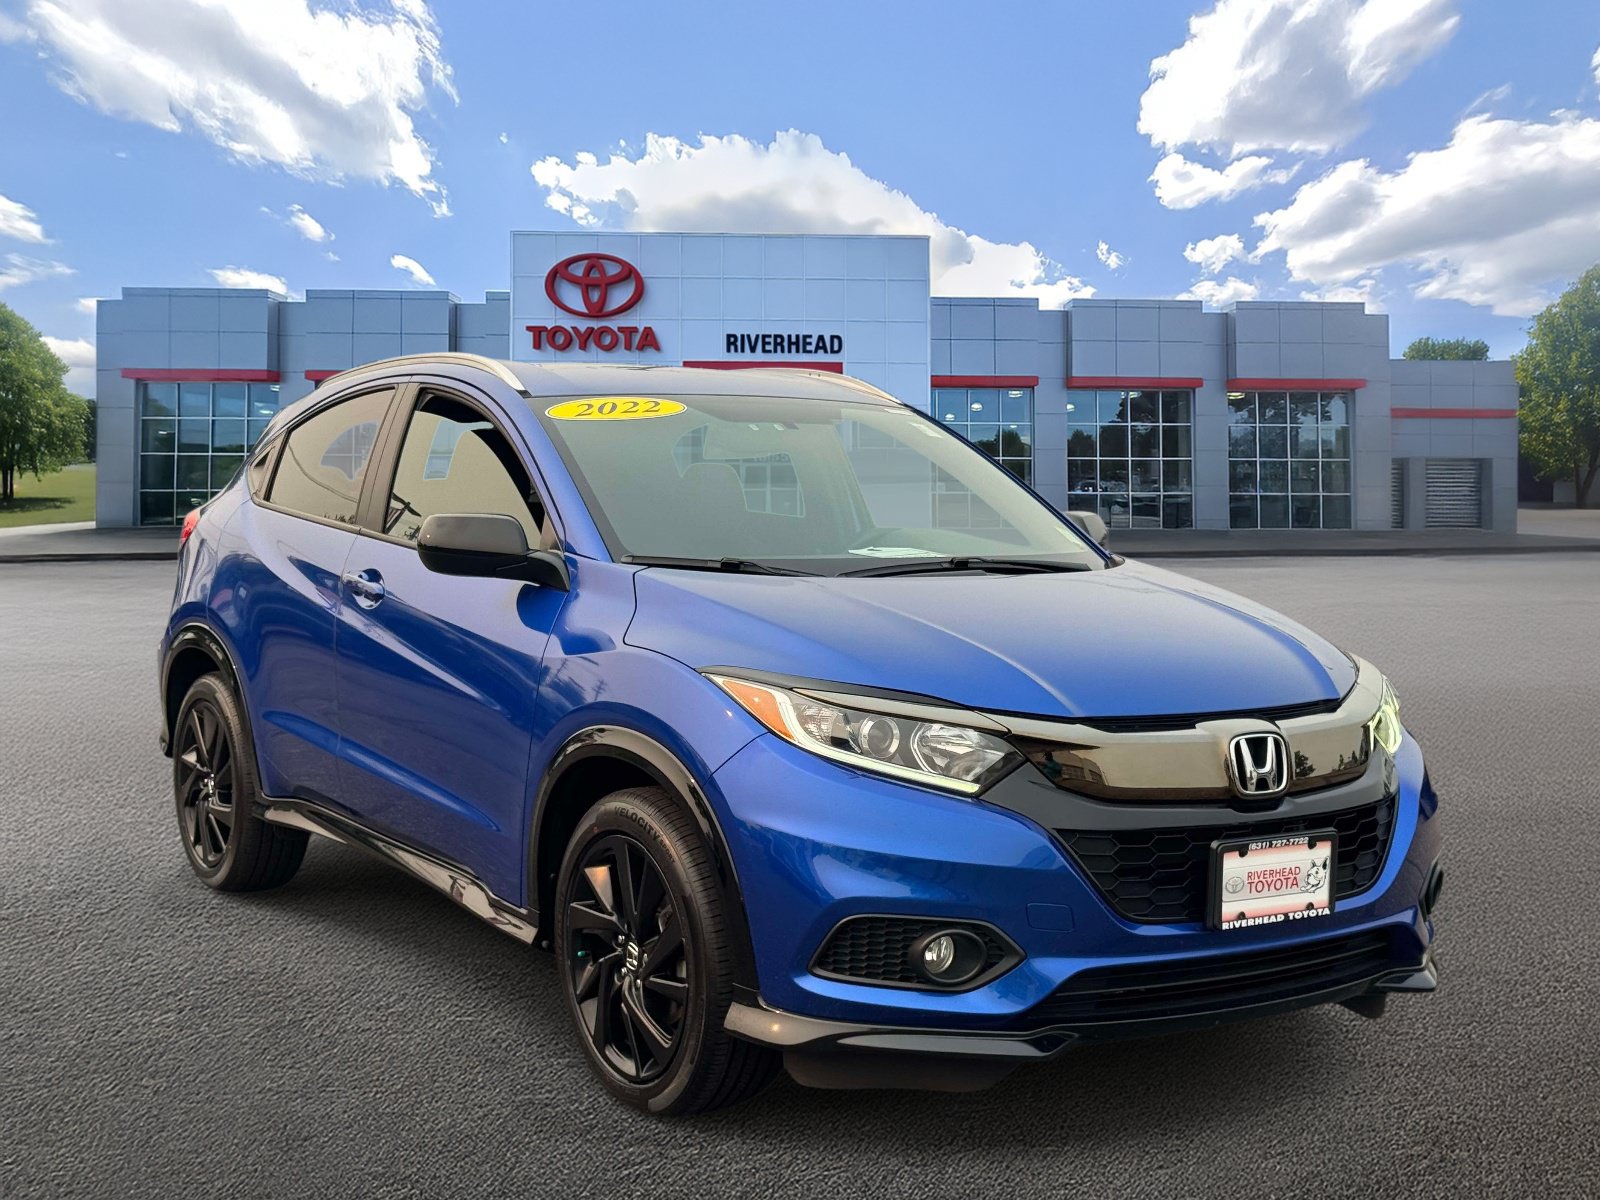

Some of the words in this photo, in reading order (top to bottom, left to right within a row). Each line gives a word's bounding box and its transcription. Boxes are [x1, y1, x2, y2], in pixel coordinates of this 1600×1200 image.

[525, 325, 661, 352] TOYOTA
[726, 333, 843, 354] RIVERHEAD
[575, 400, 661, 417] 2022
[614, 806, 660, 841] VELOCITY
[1248, 841, 1270, 850] (631)
[1271, 836, 1309, 848] 727-7722
[1247, 866, 1301, 880] RIVERHEAD
[1247, 876, 1299, 894] TOYOTA
[1222, 914, 1284, 930] RIVERHEAD
[1288, 907, 1330, 921] TOYOTA
